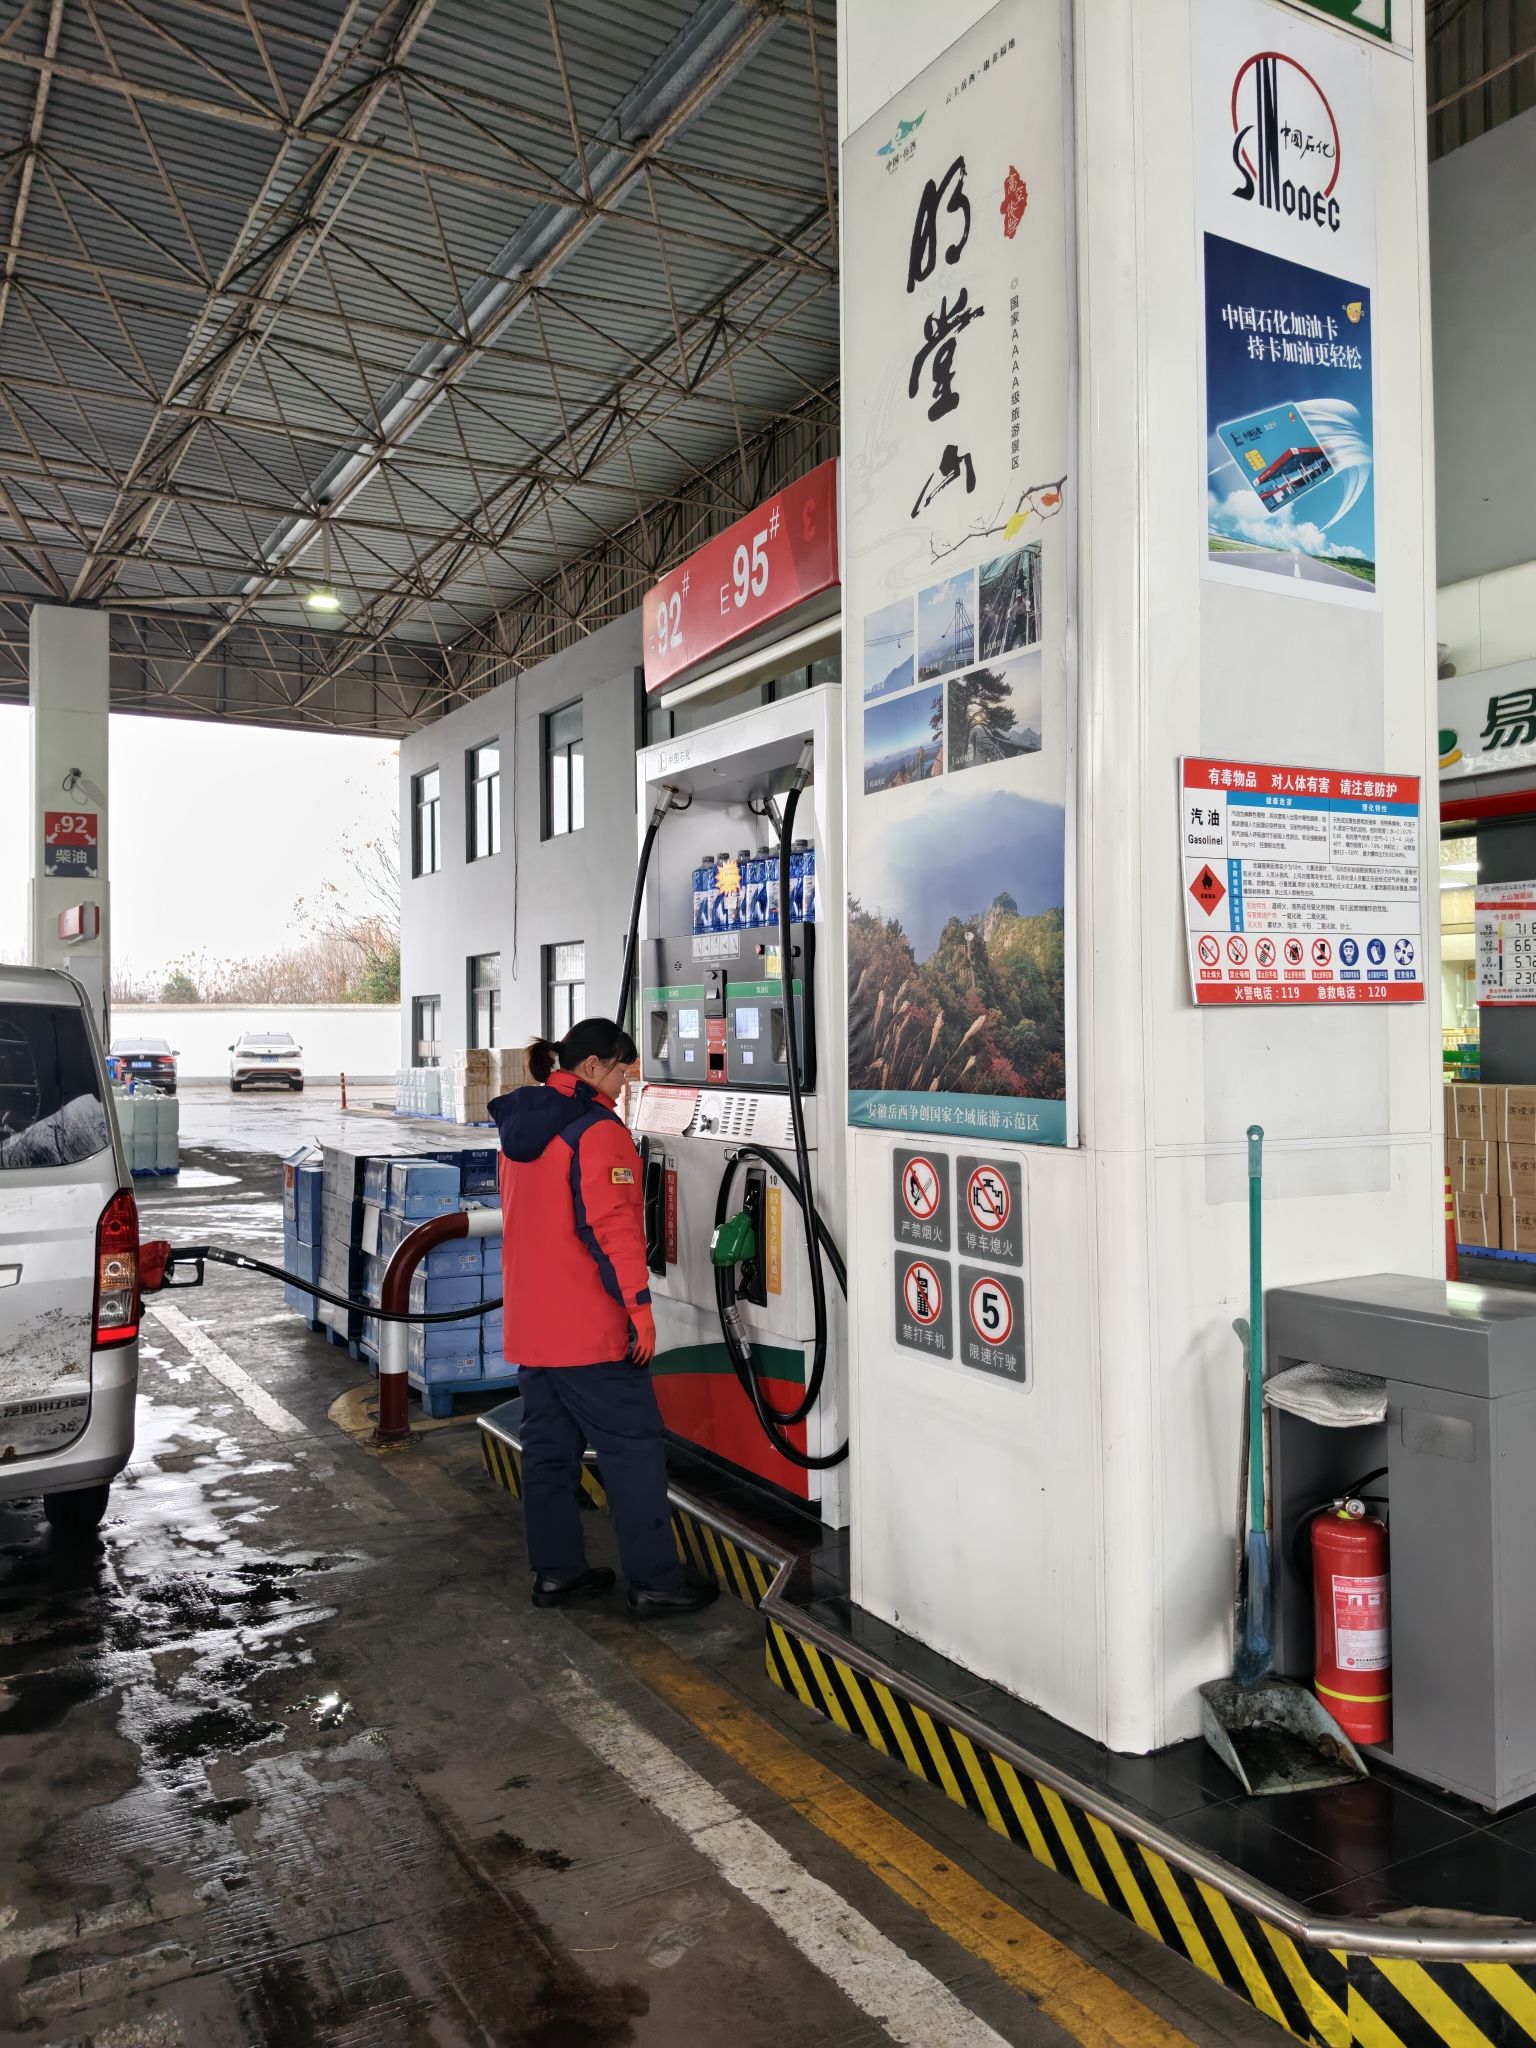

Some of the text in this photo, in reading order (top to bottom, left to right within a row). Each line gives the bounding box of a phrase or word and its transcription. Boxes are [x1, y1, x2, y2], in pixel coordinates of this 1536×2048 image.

[1280, 120, 1336, 159] 中国石化
[1221, 303, 1338, 341] 中国石化加油卡
[1247, 335, 1363, 370] 持卡加油更轻松
[1208, 767, 1398, 798] 有毒物品 对人体有害 请注意防护
[55, 849, 88, 864] 柴油
[866, 1102, 1040, 1132] 安徽岳西争创国家全域旅游示范区
[769, 1174, 778, 1186] 10
[901, 1220, 943, 1243] 严禁烟火
[966, 1232, 1014, 1258] 停车熄火
[982, 1292, 1000, 1330] 5
[902, 1322, 946, 1350] 禁打手机
[968, 1343, 1017, 1373] 限速行驶
